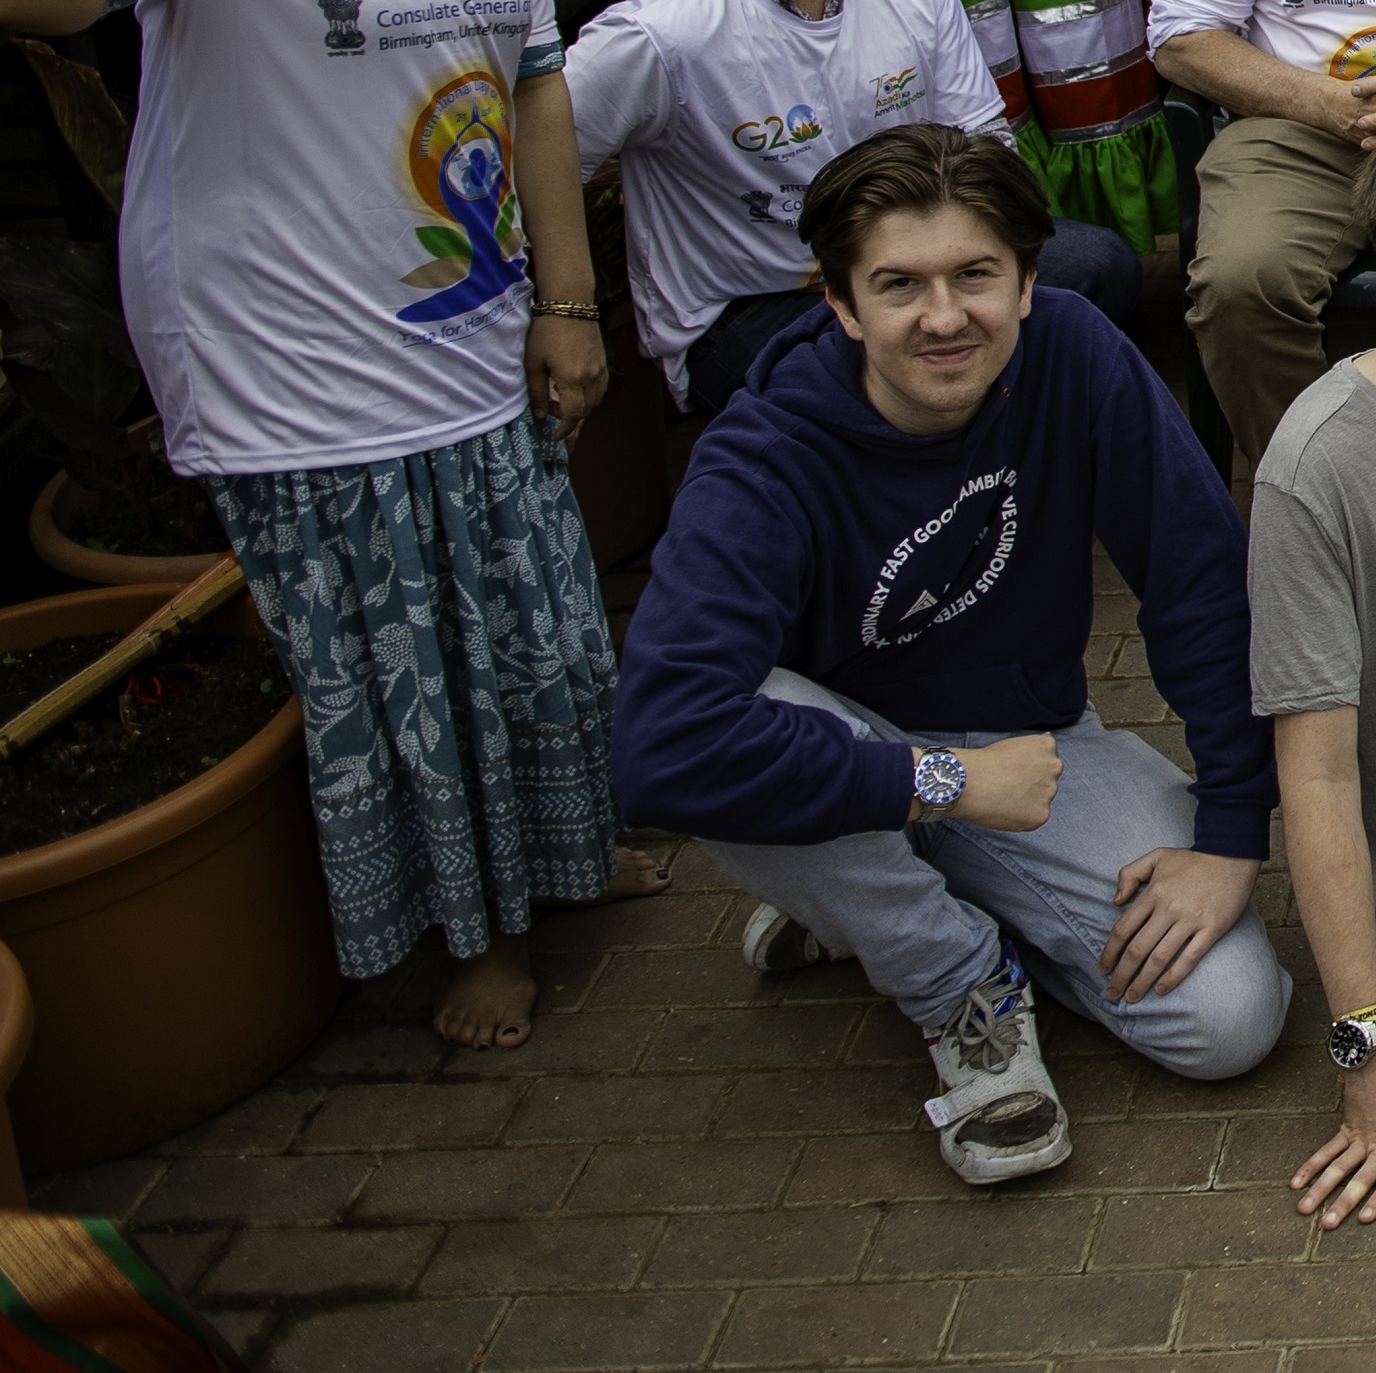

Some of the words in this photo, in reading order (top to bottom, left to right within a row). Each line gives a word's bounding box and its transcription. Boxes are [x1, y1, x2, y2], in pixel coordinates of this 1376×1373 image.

[376, 1, 460, 28] Consulate
[732, 104, 823, 152] G20
[441, 326, 462, 339] for
[880, 538, 915, 580] FAST
[975, 520, 1018, 594] CURIOUS
